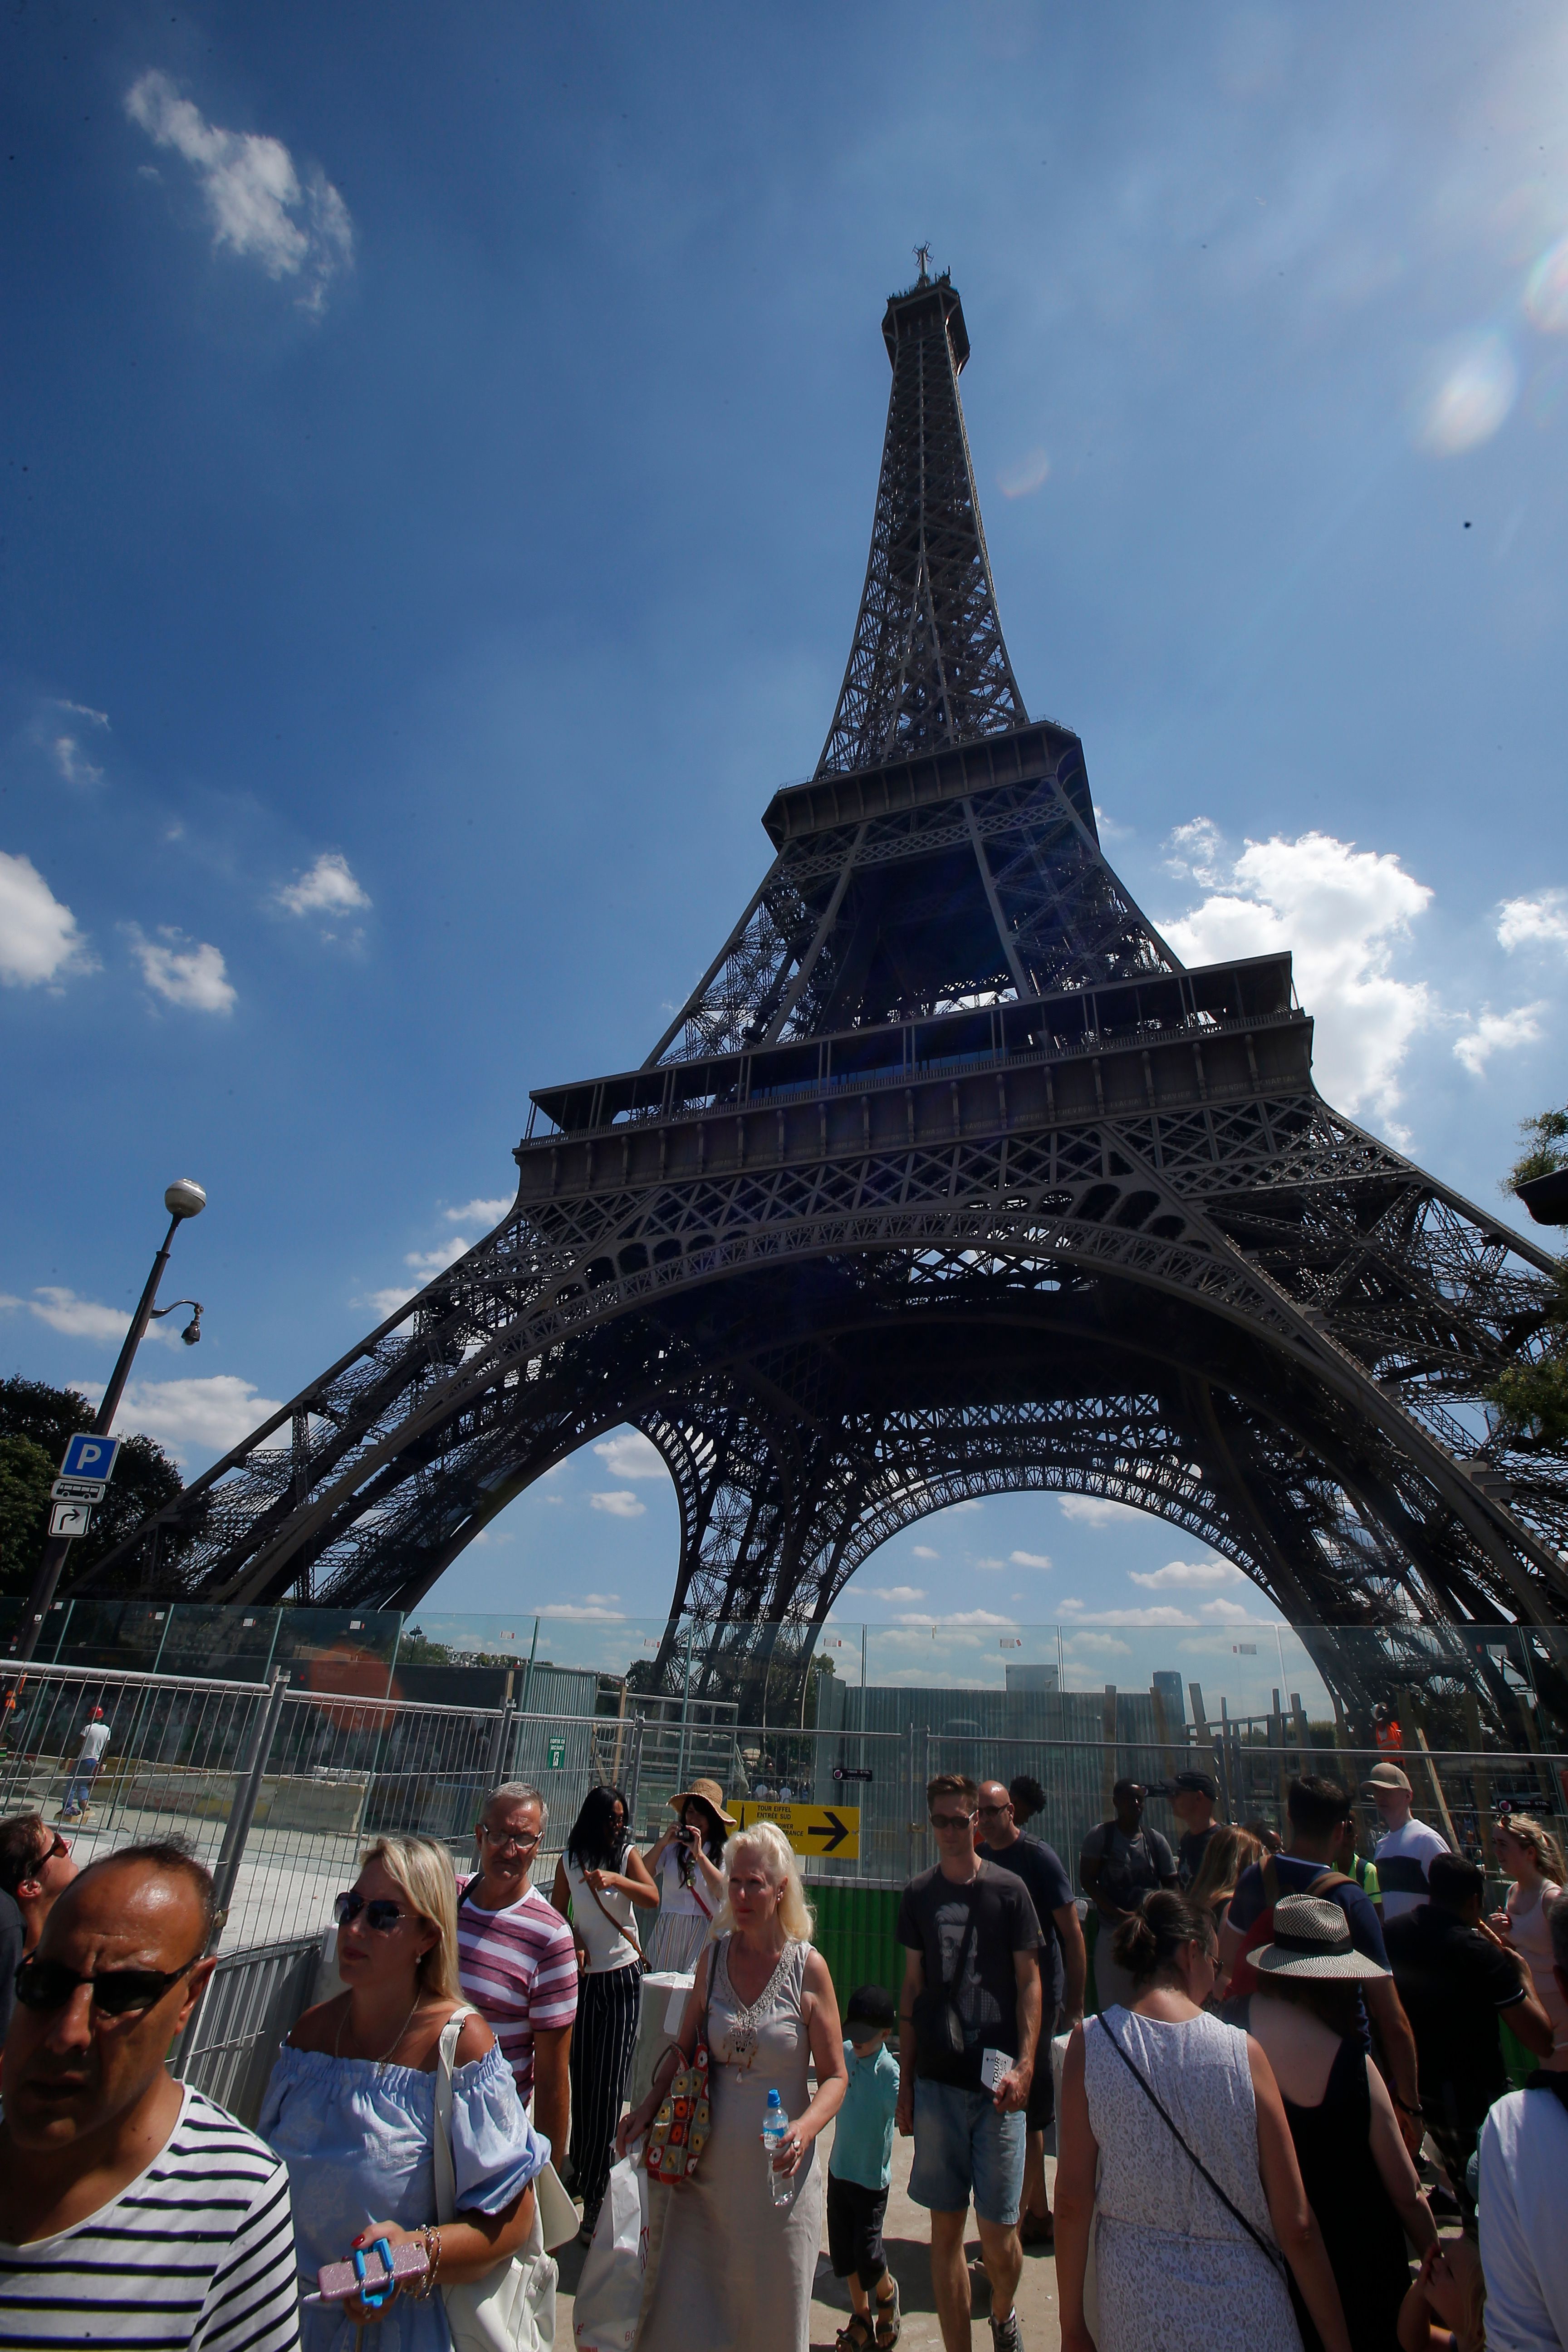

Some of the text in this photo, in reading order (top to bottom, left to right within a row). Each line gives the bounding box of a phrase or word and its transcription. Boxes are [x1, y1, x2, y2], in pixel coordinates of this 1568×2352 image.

[1211, 1082, 1249, 1093] LEGENDRE
[1161, 1091, 1190, 1100] NAVIER
[76, 1444, 101, 1469] P
